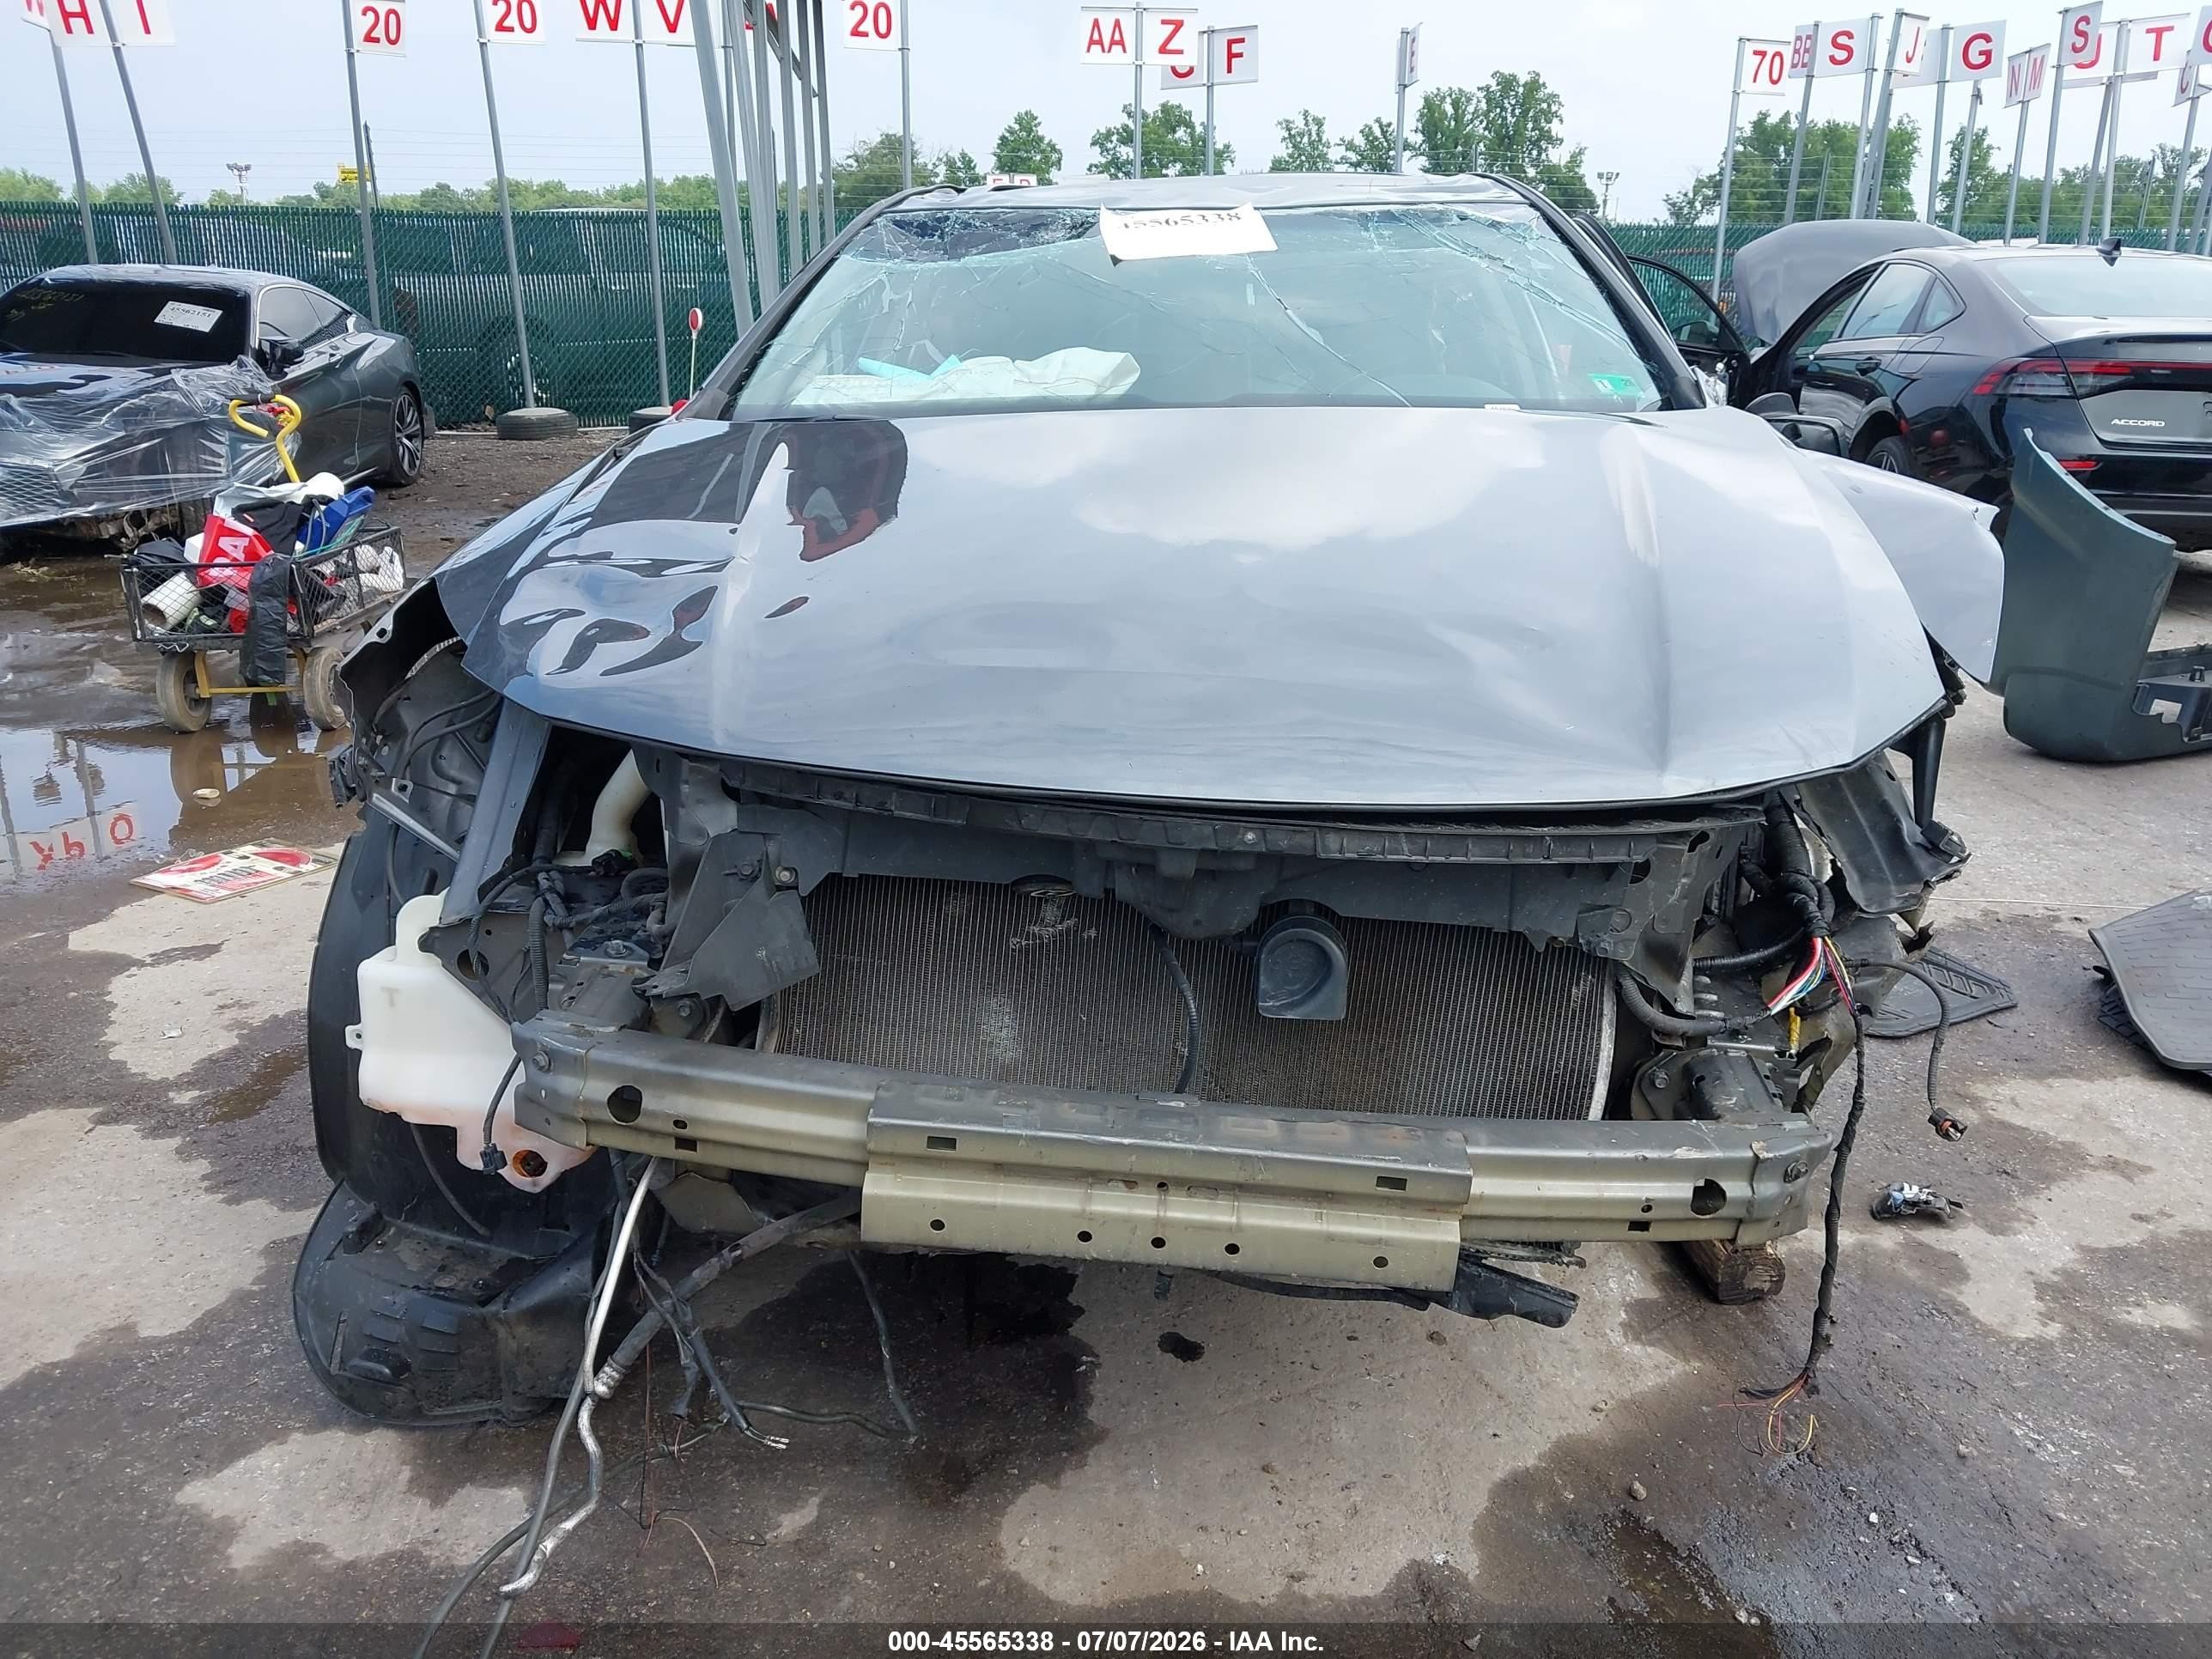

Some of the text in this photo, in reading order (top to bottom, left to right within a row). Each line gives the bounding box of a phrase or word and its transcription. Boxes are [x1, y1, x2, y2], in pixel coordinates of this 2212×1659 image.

[361, 5, 401, 46] 20
[492, 0, 537, 33] 20
[849, 0, 892, 39] 20
[2071, 15, 2091, 53] S
[1085, 18, 1127, 53] AA
[1158, 19, 1184, 54] Z
[1828, 29, 1856, 66] S
[1905, 26, 1921, 64] J
[1962, 33, 1993, 70] G
[2145, 25, 2174, 61] T
[1226, 37, 1246, 74] F
[1752, 49, 1784, 85] 70
[2029, 54, 2046, 92] M
[2009, 63, 2021, 98] N
[2111, 418, 2166, 427] ACCORD
